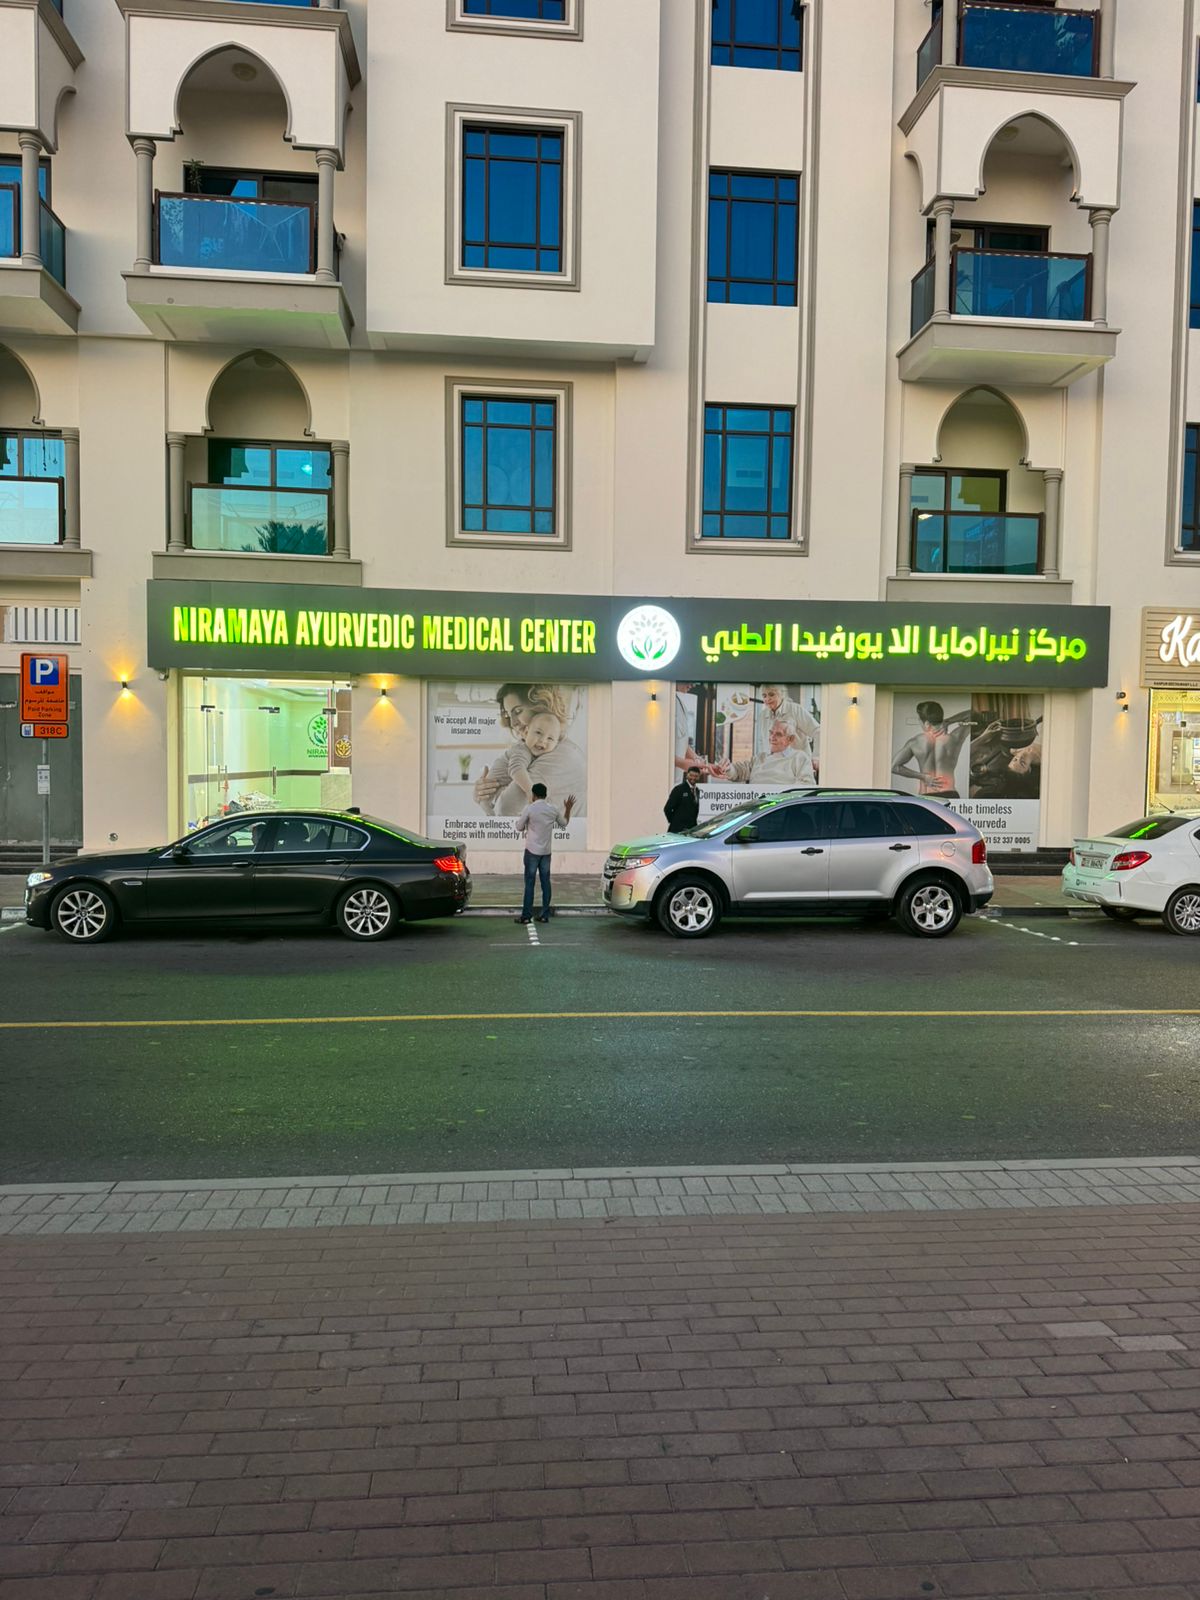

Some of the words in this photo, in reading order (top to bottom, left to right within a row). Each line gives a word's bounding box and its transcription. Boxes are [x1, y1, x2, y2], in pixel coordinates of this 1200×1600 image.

[173, 606, 289, 645] NIRAMAYA
[296, 610, 415, 650] AYURVEDIC
[422, 615, 514, 652] MEDICAL
[520, 618, 596, 654] CENTER
[701, 623, 782, 663] الطبي
[929, 626, 1020, 662] نيرامايا
[1025, 628, 1087, 663] مركز
[35, 658, 54, 684] P
[41, 705, 62, 713] Parking
[433, 715, 445, 724] We
[446, 716, 467, 725] accept
[468, 715, 478, 724] All
[478, 716, 497, 726] major
[40, 726, 63, 735] 318C
[450, 726, 482, 735] insurance
[698, 789, 760, 802] Compassionate
[959, 803, 973, 815] the
[975, 803, 1013, 815] timeless
[444, 818, 478, 829] Embrace
[442, 829, 468, 841] begins
[469, 829, 486, 839] with
[487, 829, 520, 841] motherly
[553, 832, 571, 840] care
[992, 836, 1001, 844] 52
[1002, 836, 1013, 844] 337
[1014, 836, 1031, 844] 0005
